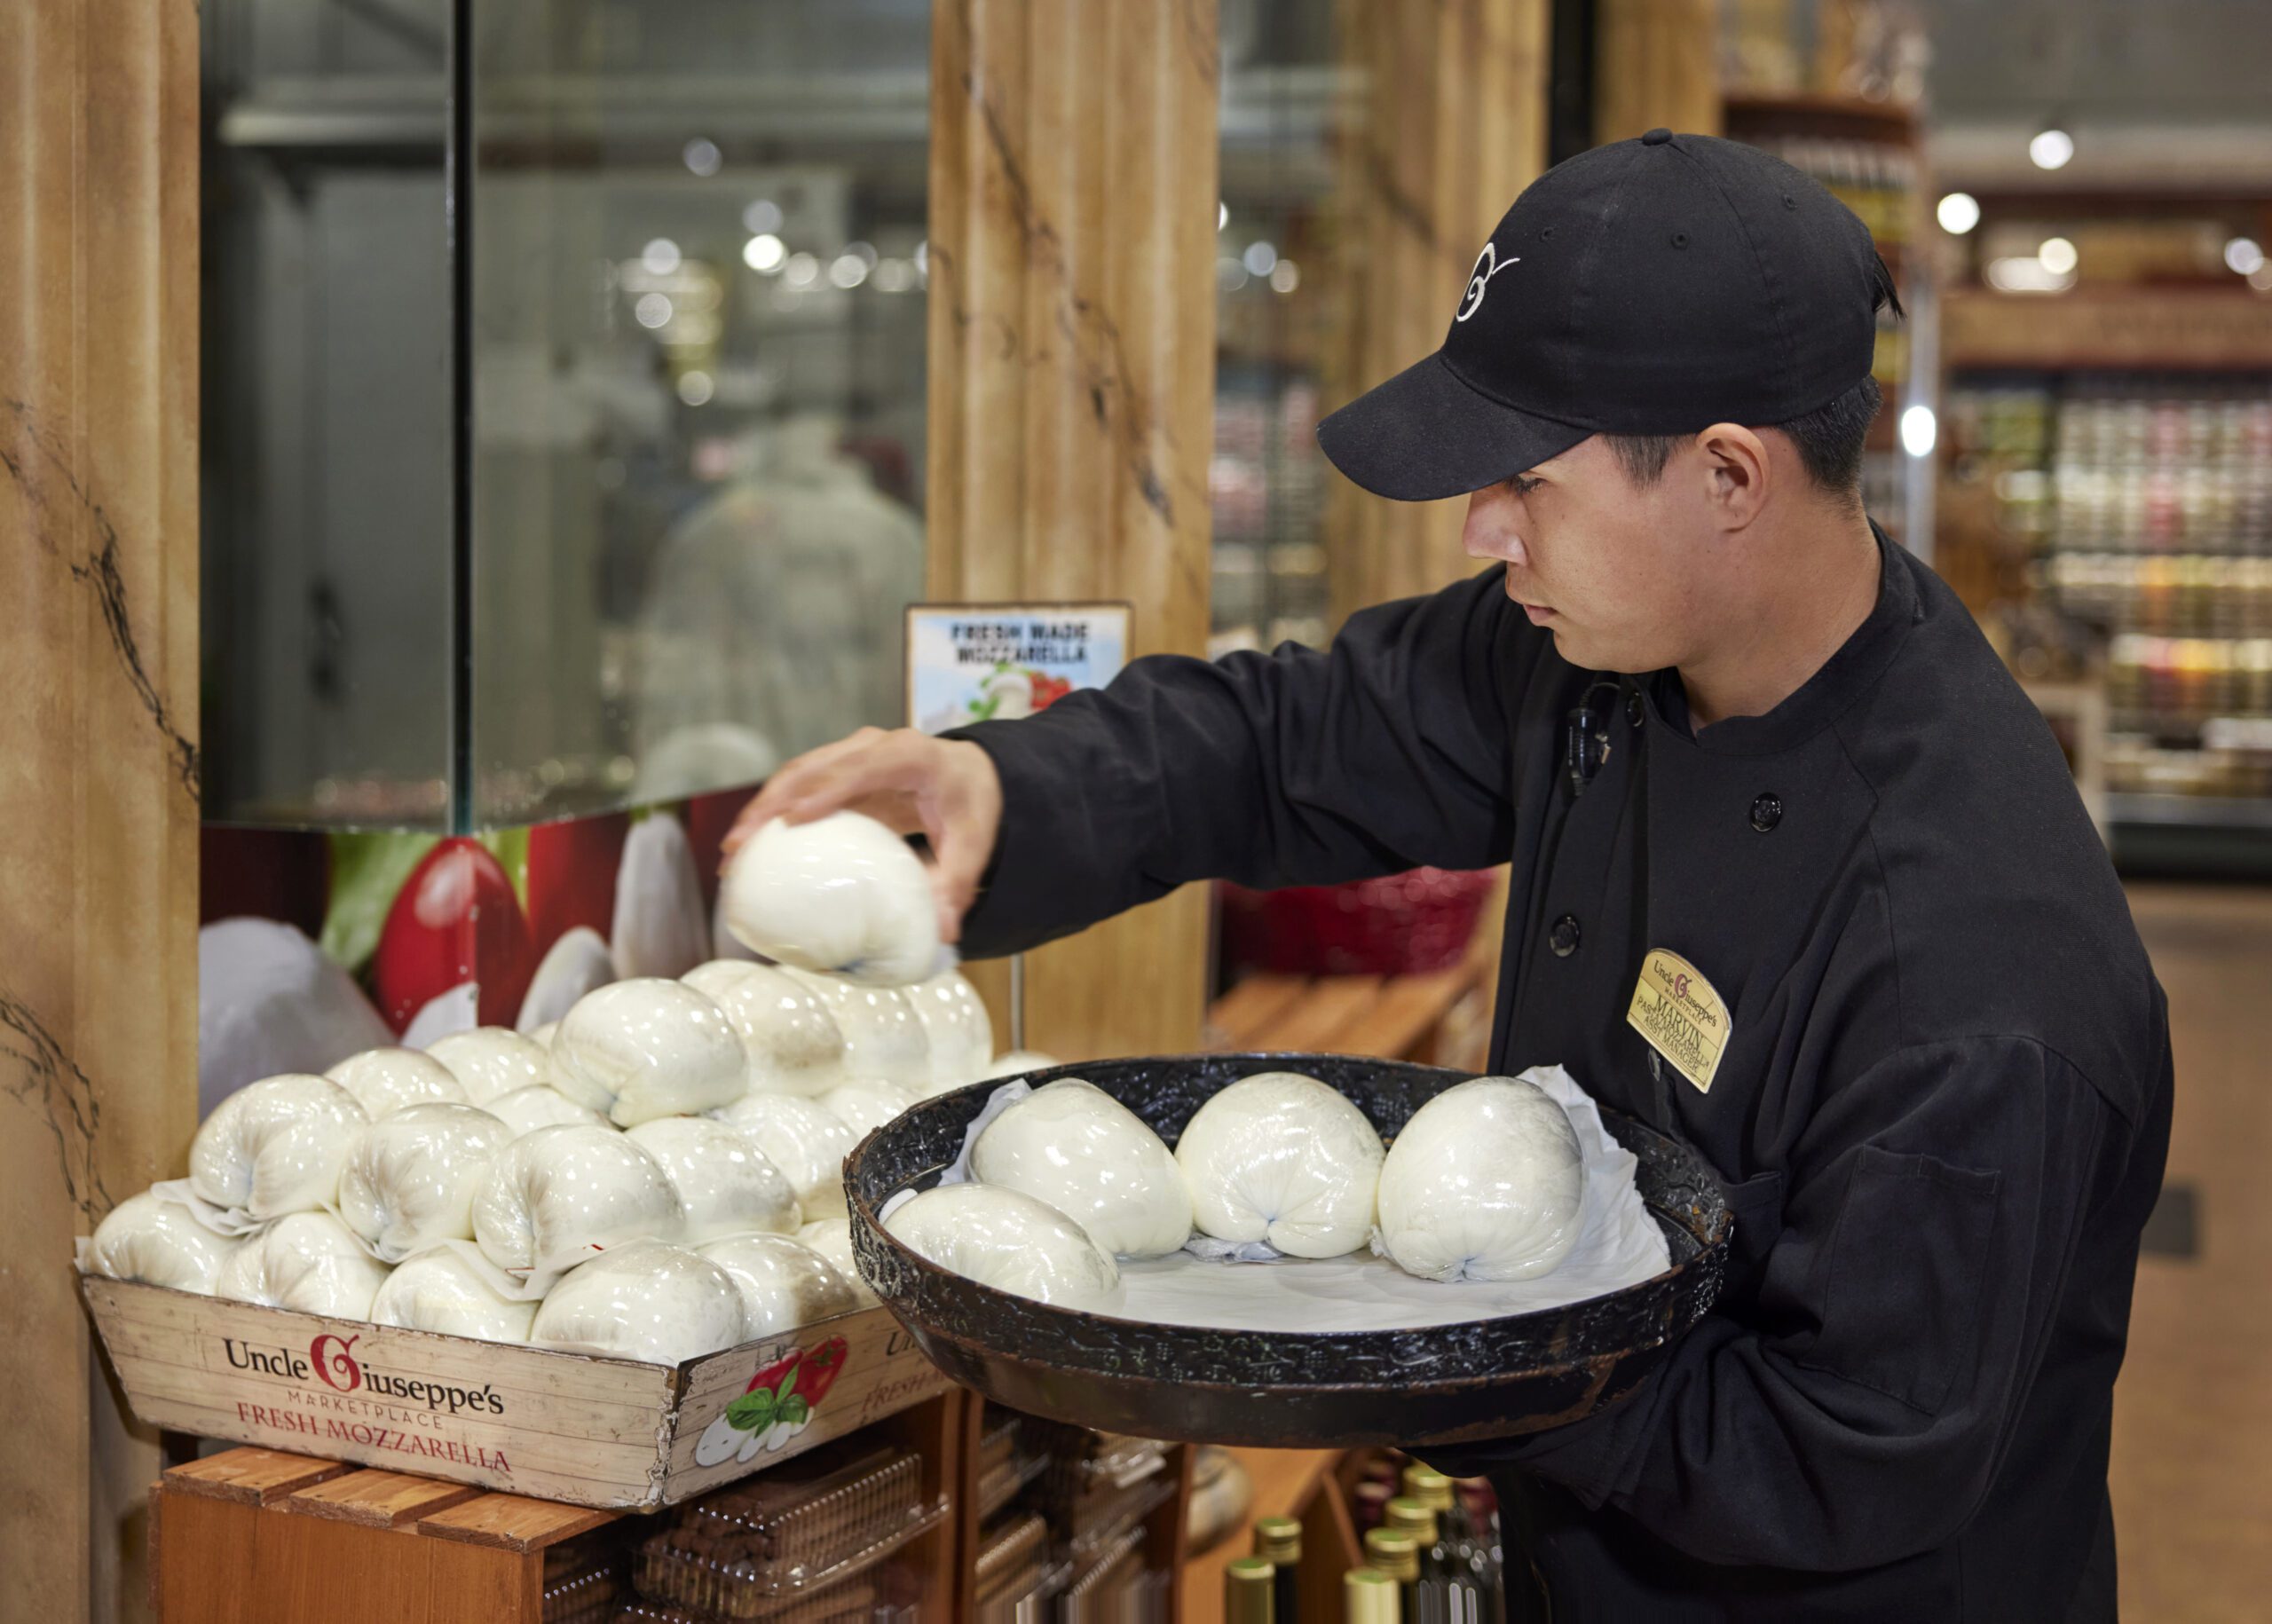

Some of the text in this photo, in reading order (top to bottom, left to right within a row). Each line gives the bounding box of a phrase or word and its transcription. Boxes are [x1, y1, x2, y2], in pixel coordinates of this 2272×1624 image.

[951, 622, 1089, 643] FRESH MADE
[1653, 960, 1717, 1028] Uncle Giuseppe's
[1653, 994, 1705, 1052] MARVIN
[1664, 986, 1702, 1026] MARKETPLACE
[222, 1334, 504, 1415] Uncle Giuseppe's
[236, 1400, 512, 1473] FRESH MOZZARELLA
[287, 1390, 444, 1431] MARKETPLACE
